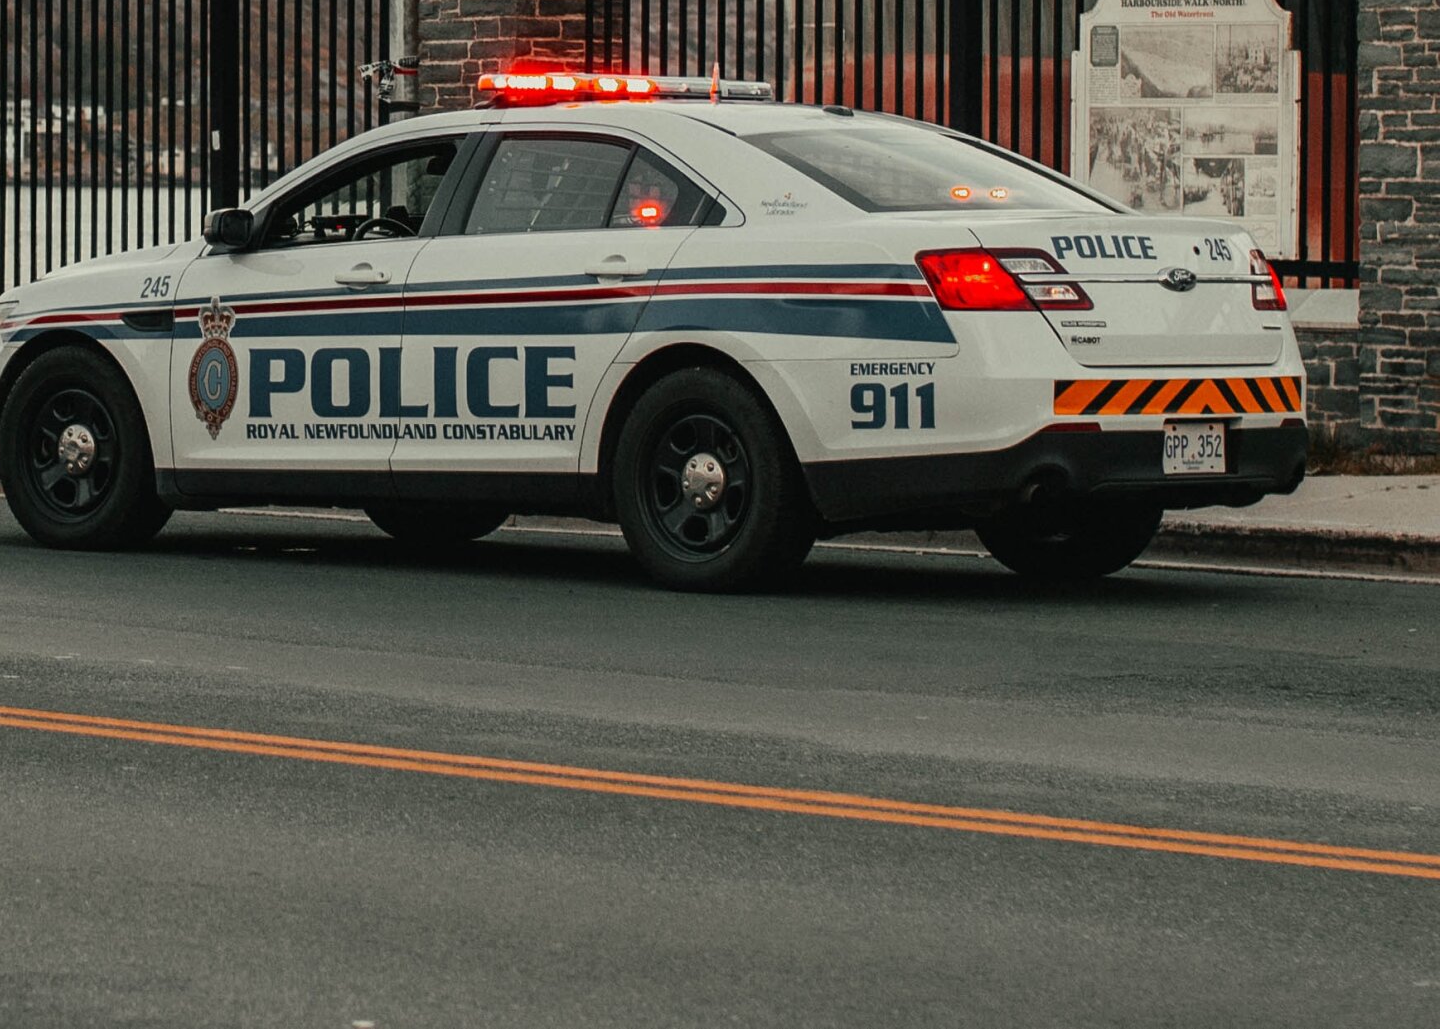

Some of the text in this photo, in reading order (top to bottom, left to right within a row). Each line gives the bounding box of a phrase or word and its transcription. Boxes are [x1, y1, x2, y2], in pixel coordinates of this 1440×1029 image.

[1051, 234, 1157, 260] POLICE
[1204, 237, 1232, 261] 245
[140, 275, 172, 298] 245
[1078, 337, 1101, 345] CABOT
[203, 360, 222, 400] C
[850, 362, 935, 376] EMERGENCY
[248, 346, 577, 418] POLICE
[850, 382, 936, 430] 911
[246, 424, 577, 441] ROYAL NEWFOUNDLAND CONSTABULARY
[1165, 434, 1222, 459] GPP 352
